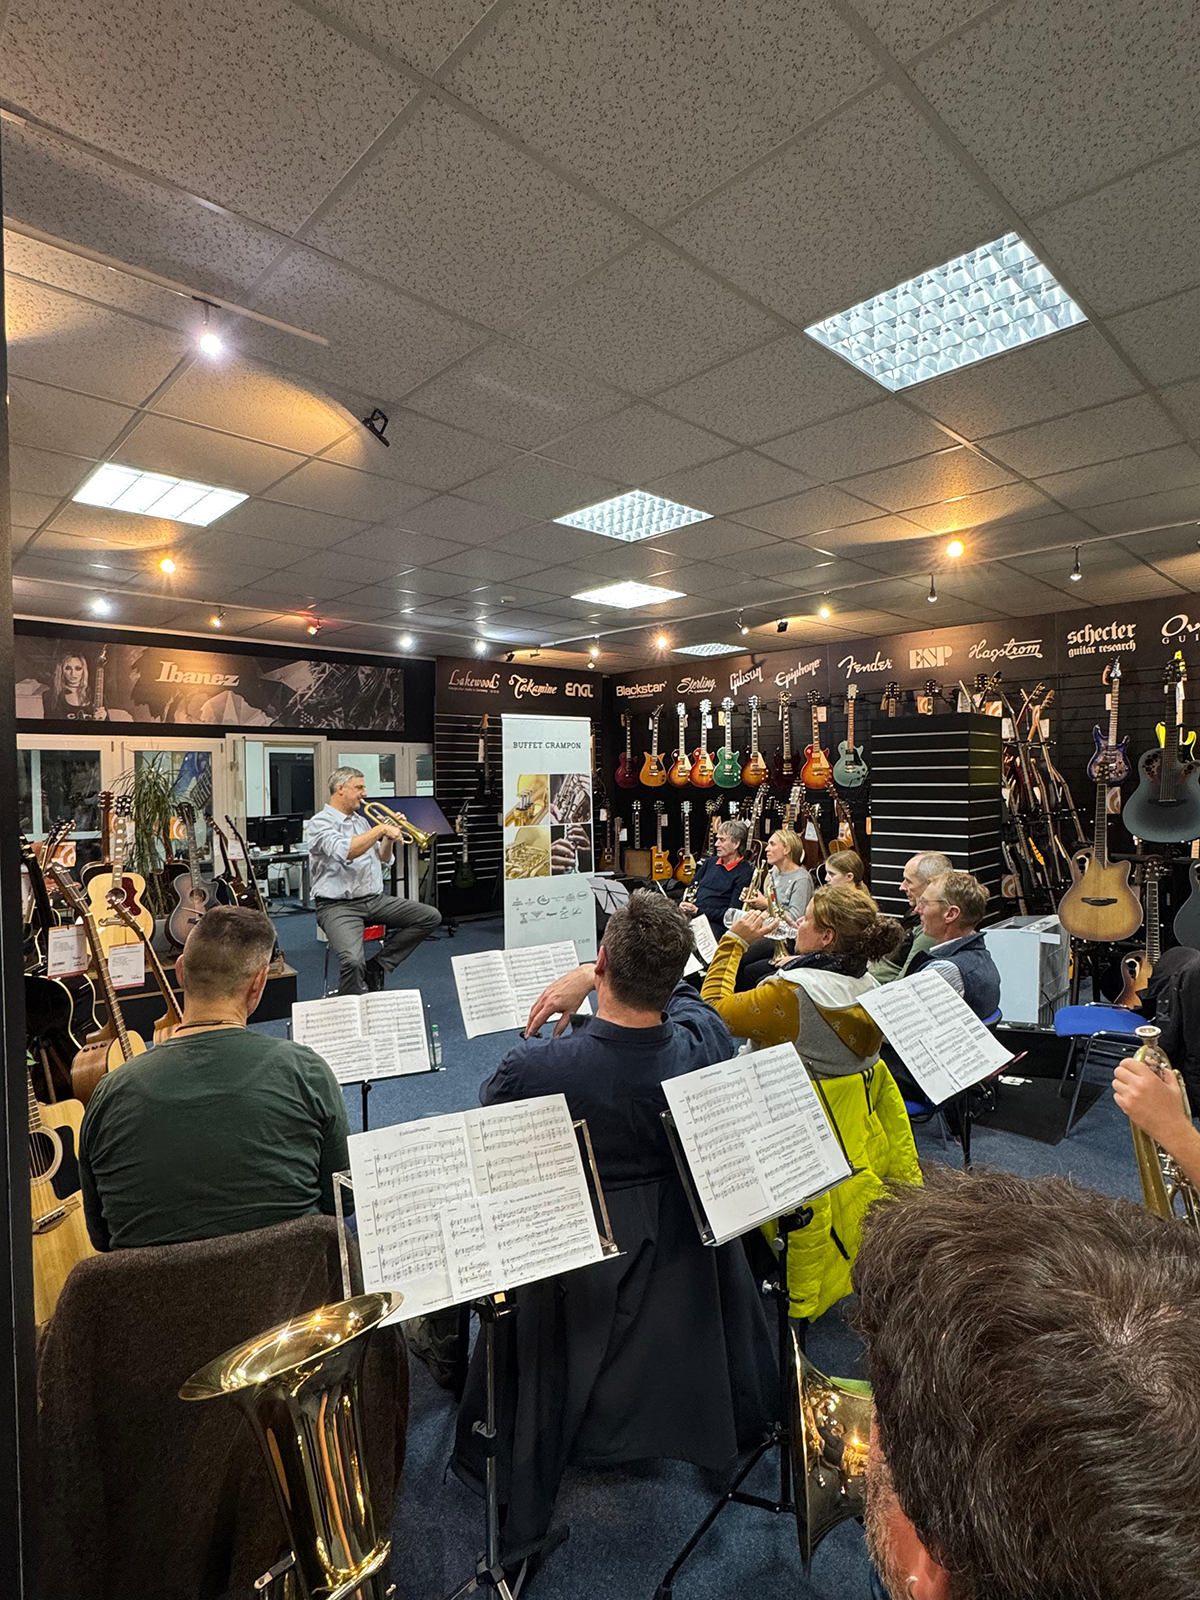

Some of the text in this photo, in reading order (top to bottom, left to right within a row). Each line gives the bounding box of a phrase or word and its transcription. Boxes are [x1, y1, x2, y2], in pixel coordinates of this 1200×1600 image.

[909, 645, 953, 669] ESP
[968, 638, 1043, 662] Hagstrom
[1068, 639, 1137, 658] guitar research
[155, 660, 240, 687] Ibanez
[774, 659, 820, 688] Epiphone
[838, 651, 892, 678] Fender
[448, 669, 500, 689] Lakewood
[508, 674, 558, 699] Takamine
[565, 682, 594, 698] ENGL
[616, 682, 665, 697] Blackstar
[676, 676, 716, 694] Sterling
[729, 666, 763, 695] Gibson
[513, 741, 581, 749] BUFFET CRAMPON
